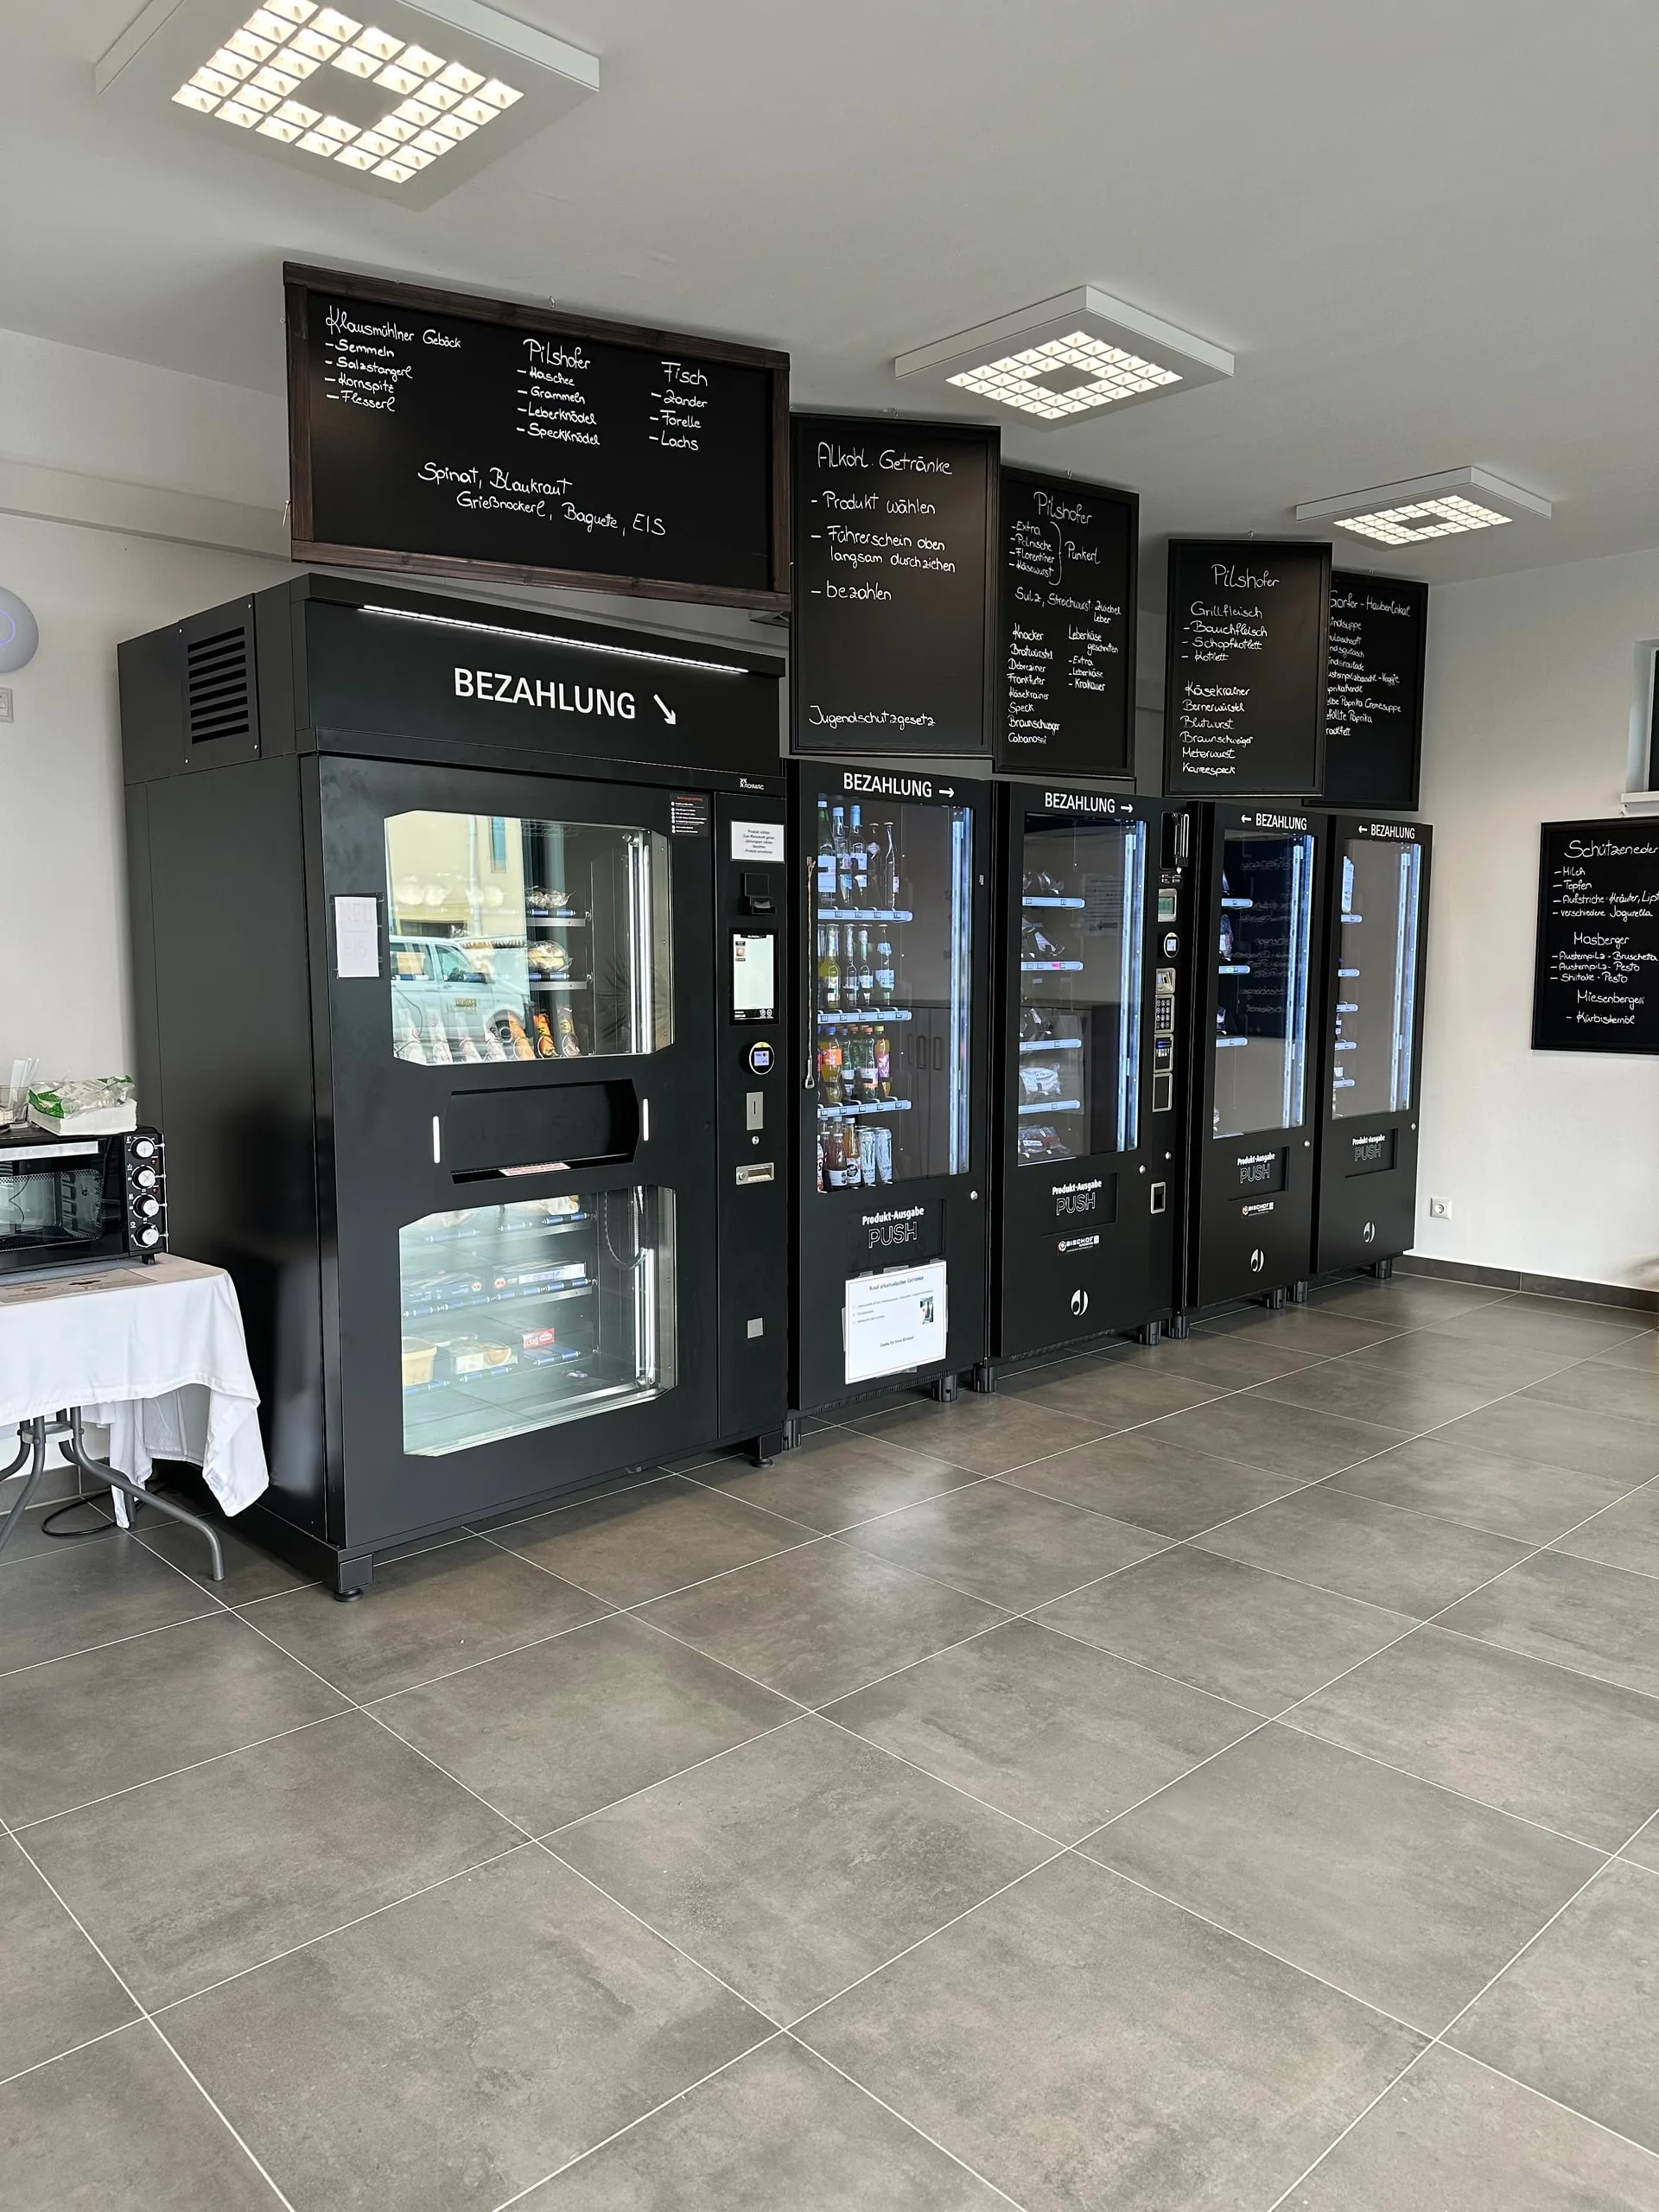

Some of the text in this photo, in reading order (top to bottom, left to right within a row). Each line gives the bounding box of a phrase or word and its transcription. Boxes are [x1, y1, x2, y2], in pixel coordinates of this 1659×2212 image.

[523, 338, 591, 370] Pilshofer
[661, 361, 709, 386] Fisch
[879, 449, 953, 474] Getränke
[489, 467, 573, 495] Blaukraut
[822, 491, 879, 511] Produkt
[886, 500, 936, 515] wählen
[1033, 491, 1092, 524] Pilshofer
[632, 513, 666, 536] EIS
[826, 524, 912, 548] Führerschein
[917, 536, 945, 551] oben
[830, 546, 883, 569] langsam
[1211, 563, 1280, 588] Pilshofer
[825, 581, 892, 601] bezahlen
[1094, 611, 1111, 624] Leber
[1190, 601, 1263, 619] Grillfleisch
[1330, 616, 1362, 632] indsuppe
[454, 666, 637, 720] BEZAHLUNG
[1008, 702, 1034, 715] Speck
[843, 772, 932, 798] BEZAHLUNG
[1045, 791, 1116, 814] BEZAHLUNG
[1255, 812, 1307, 831] BEZAHLUNG
[1370, 823, 1415, 840] BEZAHLUNG
[1601, 971, 1628, 983] Pesto
[1612, 961, 1640, 972] Pesto
[1352, 1134, 1386, 1146] Produkt-Ausgabe
[1236, 1151, 1275, 1166] Produkt-Ausgabe
[1354, 1144, 1382, 1162] PUSH
[1239, 1163, 1270, 1184] PUSH
[1052, 1179, 1103, 1196] Produkt-Ausgabe
[1056, 1192, 1096, 1216] PUSH
[861, 1206, 925, 1226] Produkt-Ausgabe
[868, 1221, 918, 1249] PUSH
